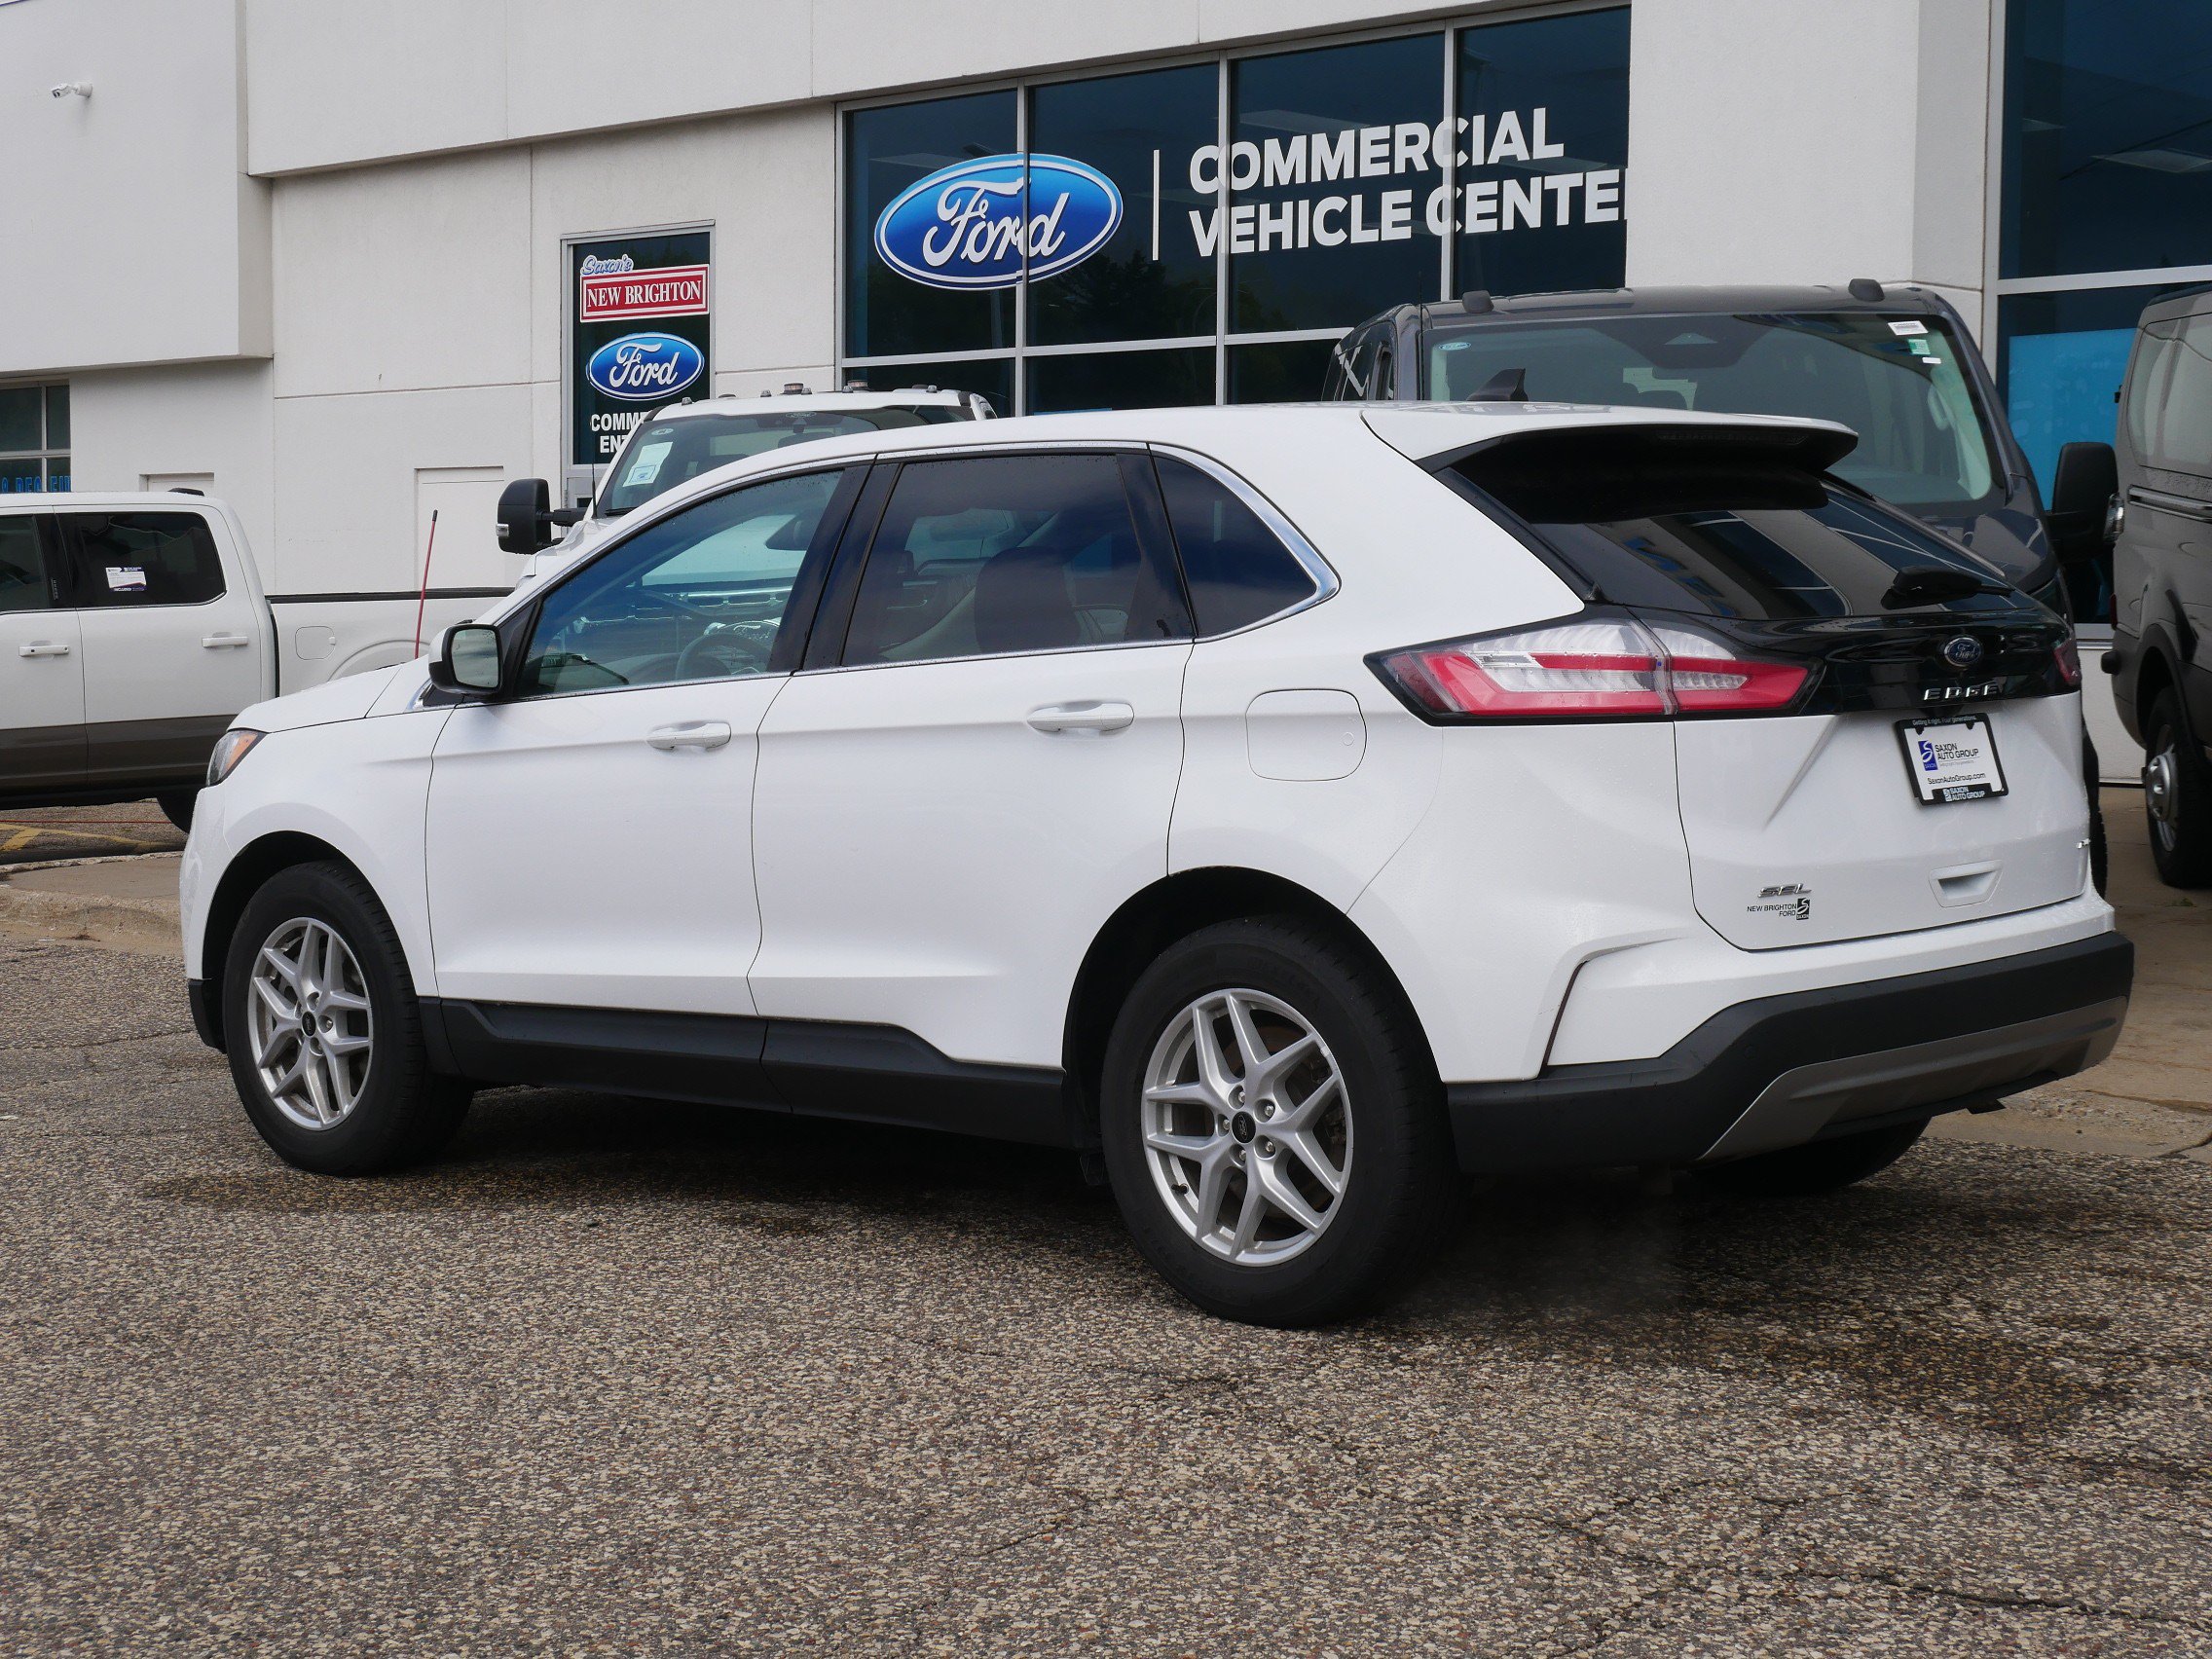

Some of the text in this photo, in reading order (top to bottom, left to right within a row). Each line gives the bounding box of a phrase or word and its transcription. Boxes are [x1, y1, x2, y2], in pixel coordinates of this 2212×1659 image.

[1189, 107, 1565, 195] COMMERCIAL
[922, 176, 1070, 267] Ford
[1188, 167, 1629, 257] VEHICLE CENTE
[582, 255, 633, 276] Saxon's
[587, 279, 701, 308] NEW BRIGHTON
[608, 343, 681, 387] Ford
[1924, 684, 1999, 700] EDGE
[1935, 743, 1958, 752] SAXON
[1937, 748, 1979, 760] AUTO GROUP
[1927, 772, 1986, 784] SaxonAutoGroup.com
